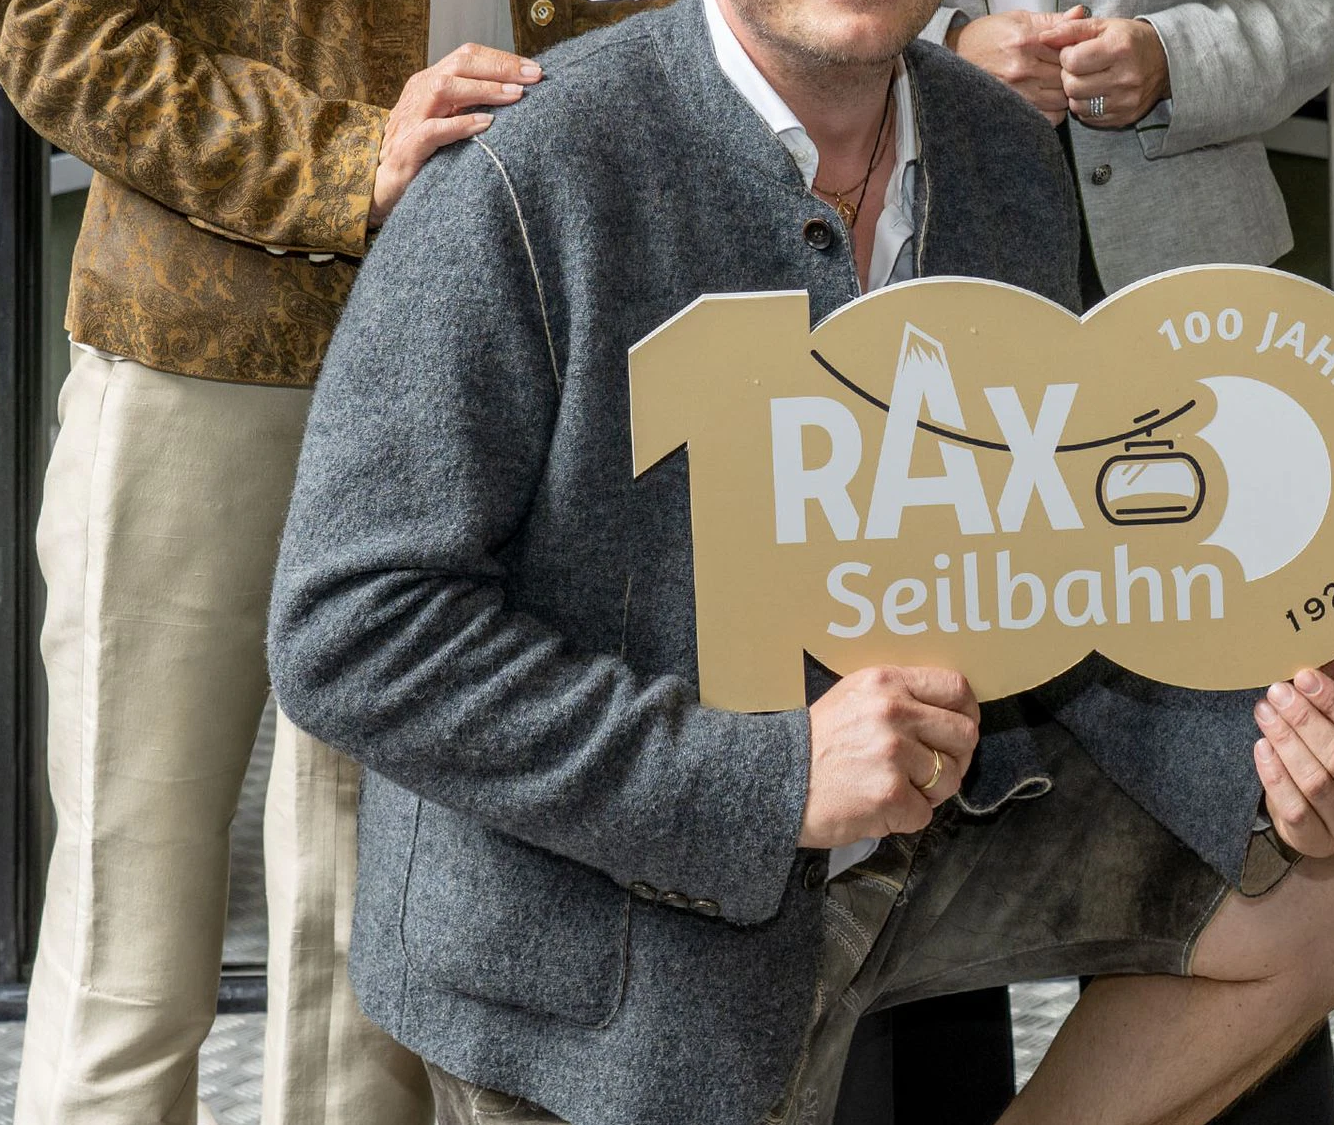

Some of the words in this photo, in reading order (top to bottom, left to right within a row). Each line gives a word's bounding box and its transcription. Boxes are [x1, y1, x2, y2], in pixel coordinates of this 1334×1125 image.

[1158, 307, 1244, 352] 100
[770, 321, 1085, 544] RAX
[827, 543, 1225, 639] Seilbahn
